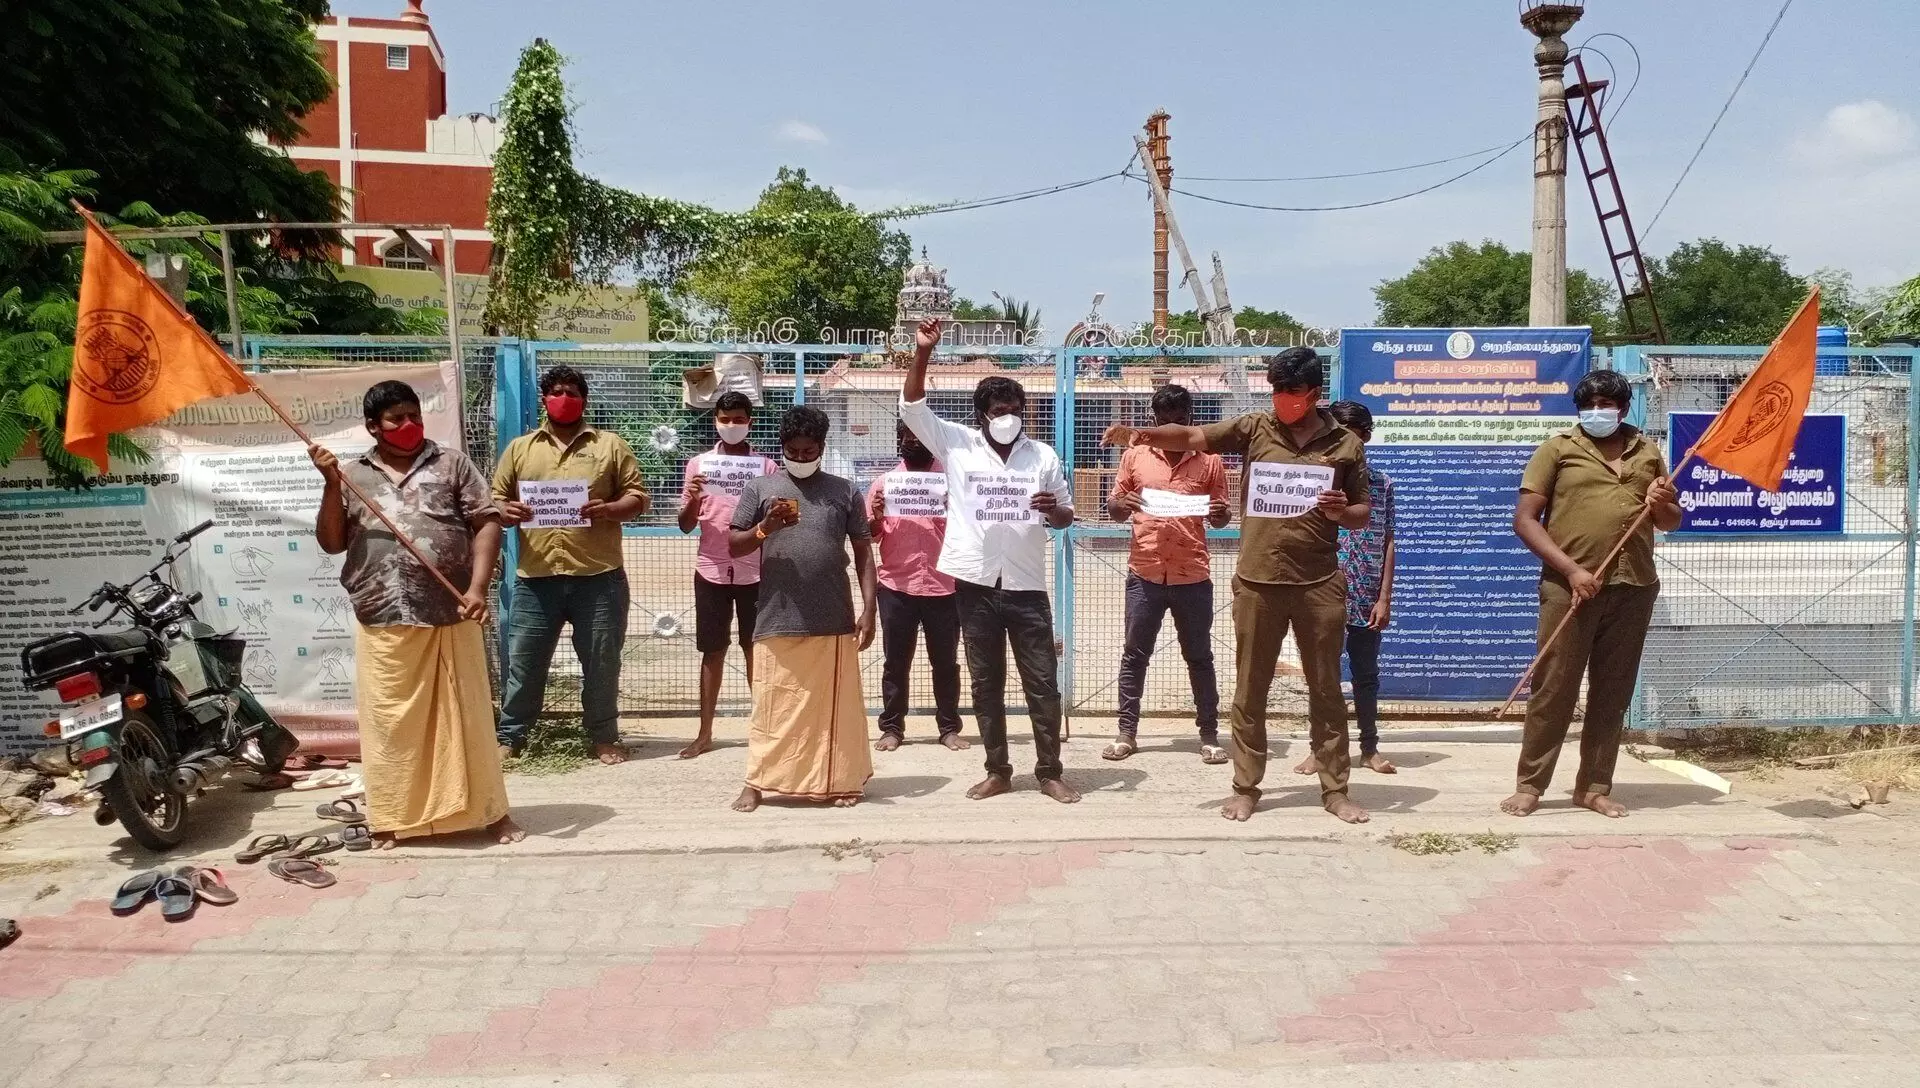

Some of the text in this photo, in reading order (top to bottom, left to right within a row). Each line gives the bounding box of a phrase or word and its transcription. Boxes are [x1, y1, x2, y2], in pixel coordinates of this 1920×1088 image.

[1371, 340, 1581, 354] இந்து சமய அறநிலையத்துறை
[1399, 361, 1531, 376] முக்கிய அறிவிப்பு
[1484, 419, 1514, 432] தொற்று
[1517, 419, 1540, 429] நோய்
[1384, 432, 1410, 443] தடுக்க
[1458, 433, 1495, 442] வேண்டிய
[125, 472, 180, 486] நலத்துறை
[1692, 466, 1718, 483] இந்து
[985, 498, 1019, 509] திறக்க
[1679, 485, 1835, 515] ஆய்வாளர் அலுவலகம்
[975, 510, 1031, 522] போராட்டம்
